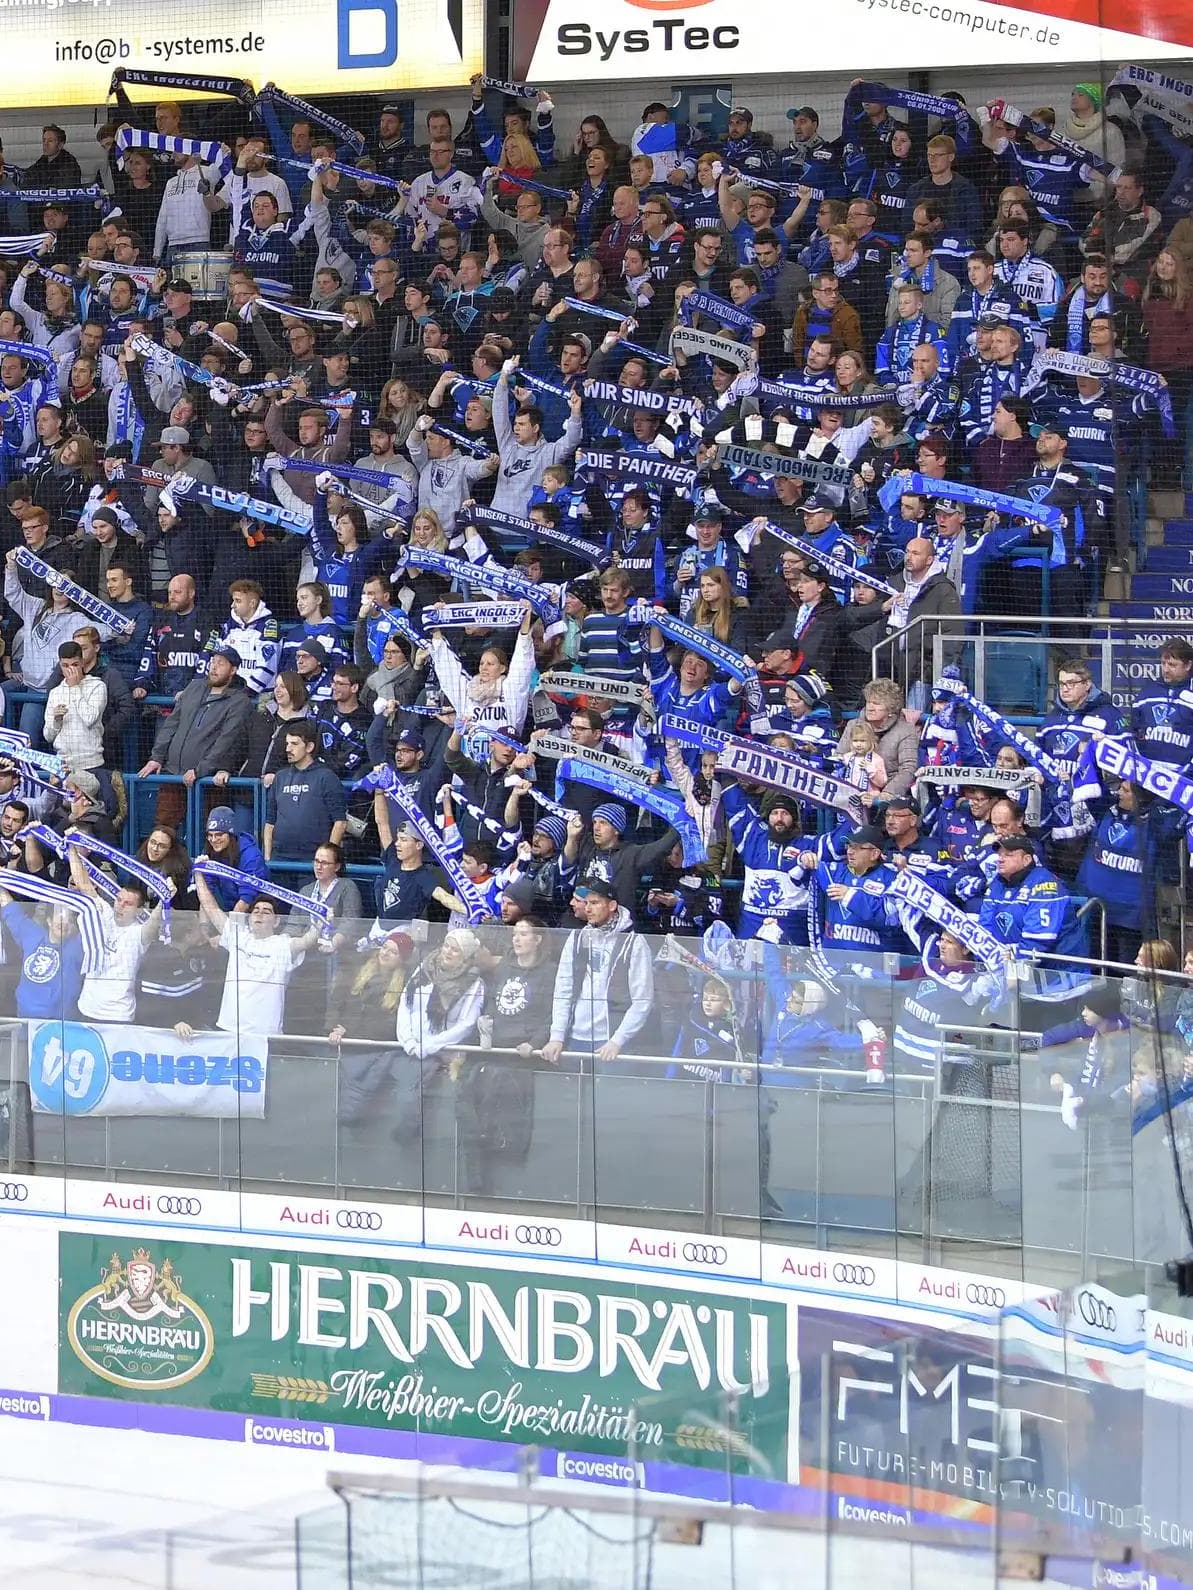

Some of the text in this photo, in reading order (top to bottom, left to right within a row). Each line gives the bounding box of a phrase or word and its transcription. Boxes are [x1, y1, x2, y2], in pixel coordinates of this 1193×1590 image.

[557, 19, 740, 60] SysTec
[245, 251, 280, 264] SATURN
[585, 381, 610, 400] WIR
[621, 386, 665, 408] SIND
[1067, 425, 1107, 442] SATURN
[587, 452, 698, 485] DIE PANTHER
[722, 445, 819, 480] INGOLSTADT
[507, 515, 537, 531] STADT
[616, 557, 652, 570] SATURN
[16, 549, 129, 634] 50 JAHRE
[445, 557, 550, 604] INGOLSTADT
[541, 677, 598, 693] MPFEN
[601, 682, 629, 695] UND
[472, 706, 508, 721] SATUR
[666, 714, 699, 734] ERC
[1144, 726, 1191, 750] SATURN
[536, 738, 608, 764] SIEGEN UND
[731, 749, 839, 802] PANTHER
[974, 768, 1021, 782] GEHT'S
[1101, 850, 1144, 874] SATURN
[1039, 908, 1050, 928] 5
[832, 923, 881, 946] SATURN
[103, 1191, 152, 1212] Audi
[279, 1205, 330, 1226] Audi
[458, 1220, 509, 1242] Audi
[628, 1237, 677, 1259] Audi
[781, 1256, 828, 1280] Audi
[918, 1275, 961, 1300] Audi
[81, 1318, 201, 1351] HERRNBRÄU
[230, 1257, 770, 1399] HERRNBRÄU
[1154, 1322, 1189, 1348] Audi
[329, 1368, 664, 1447] Weißbier-Spezialitäten
[252, 1425, 325, 1447] covestro
[563, 1457, 635, 1482] covestro
